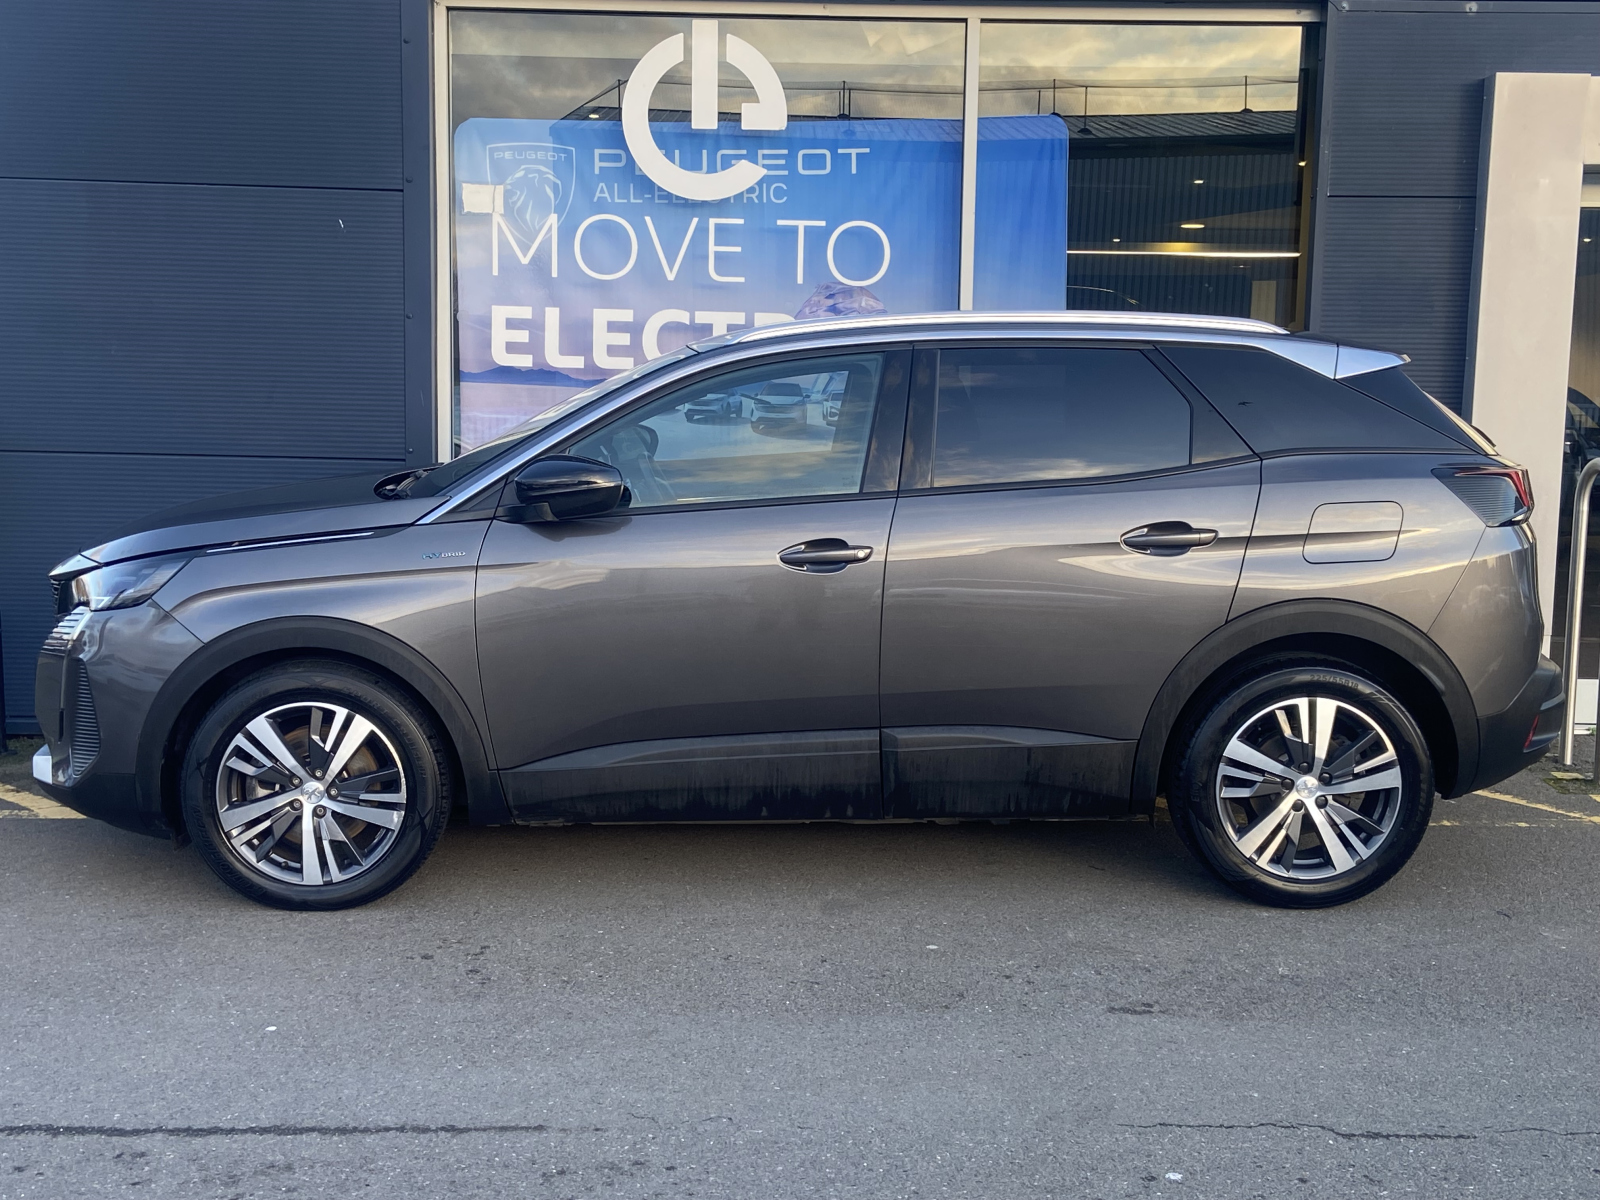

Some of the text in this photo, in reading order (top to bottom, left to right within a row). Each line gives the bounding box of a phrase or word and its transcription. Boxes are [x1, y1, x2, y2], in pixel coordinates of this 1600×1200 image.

[493, 151, 568, 162] PEUGEOT
[594, 147, 870, 176] PUGEOT
[491, 212, 891, 287] MOVE TO
[491, 305, 796, 370] ELECT
[421, 550, 467, 560] HYBRID
